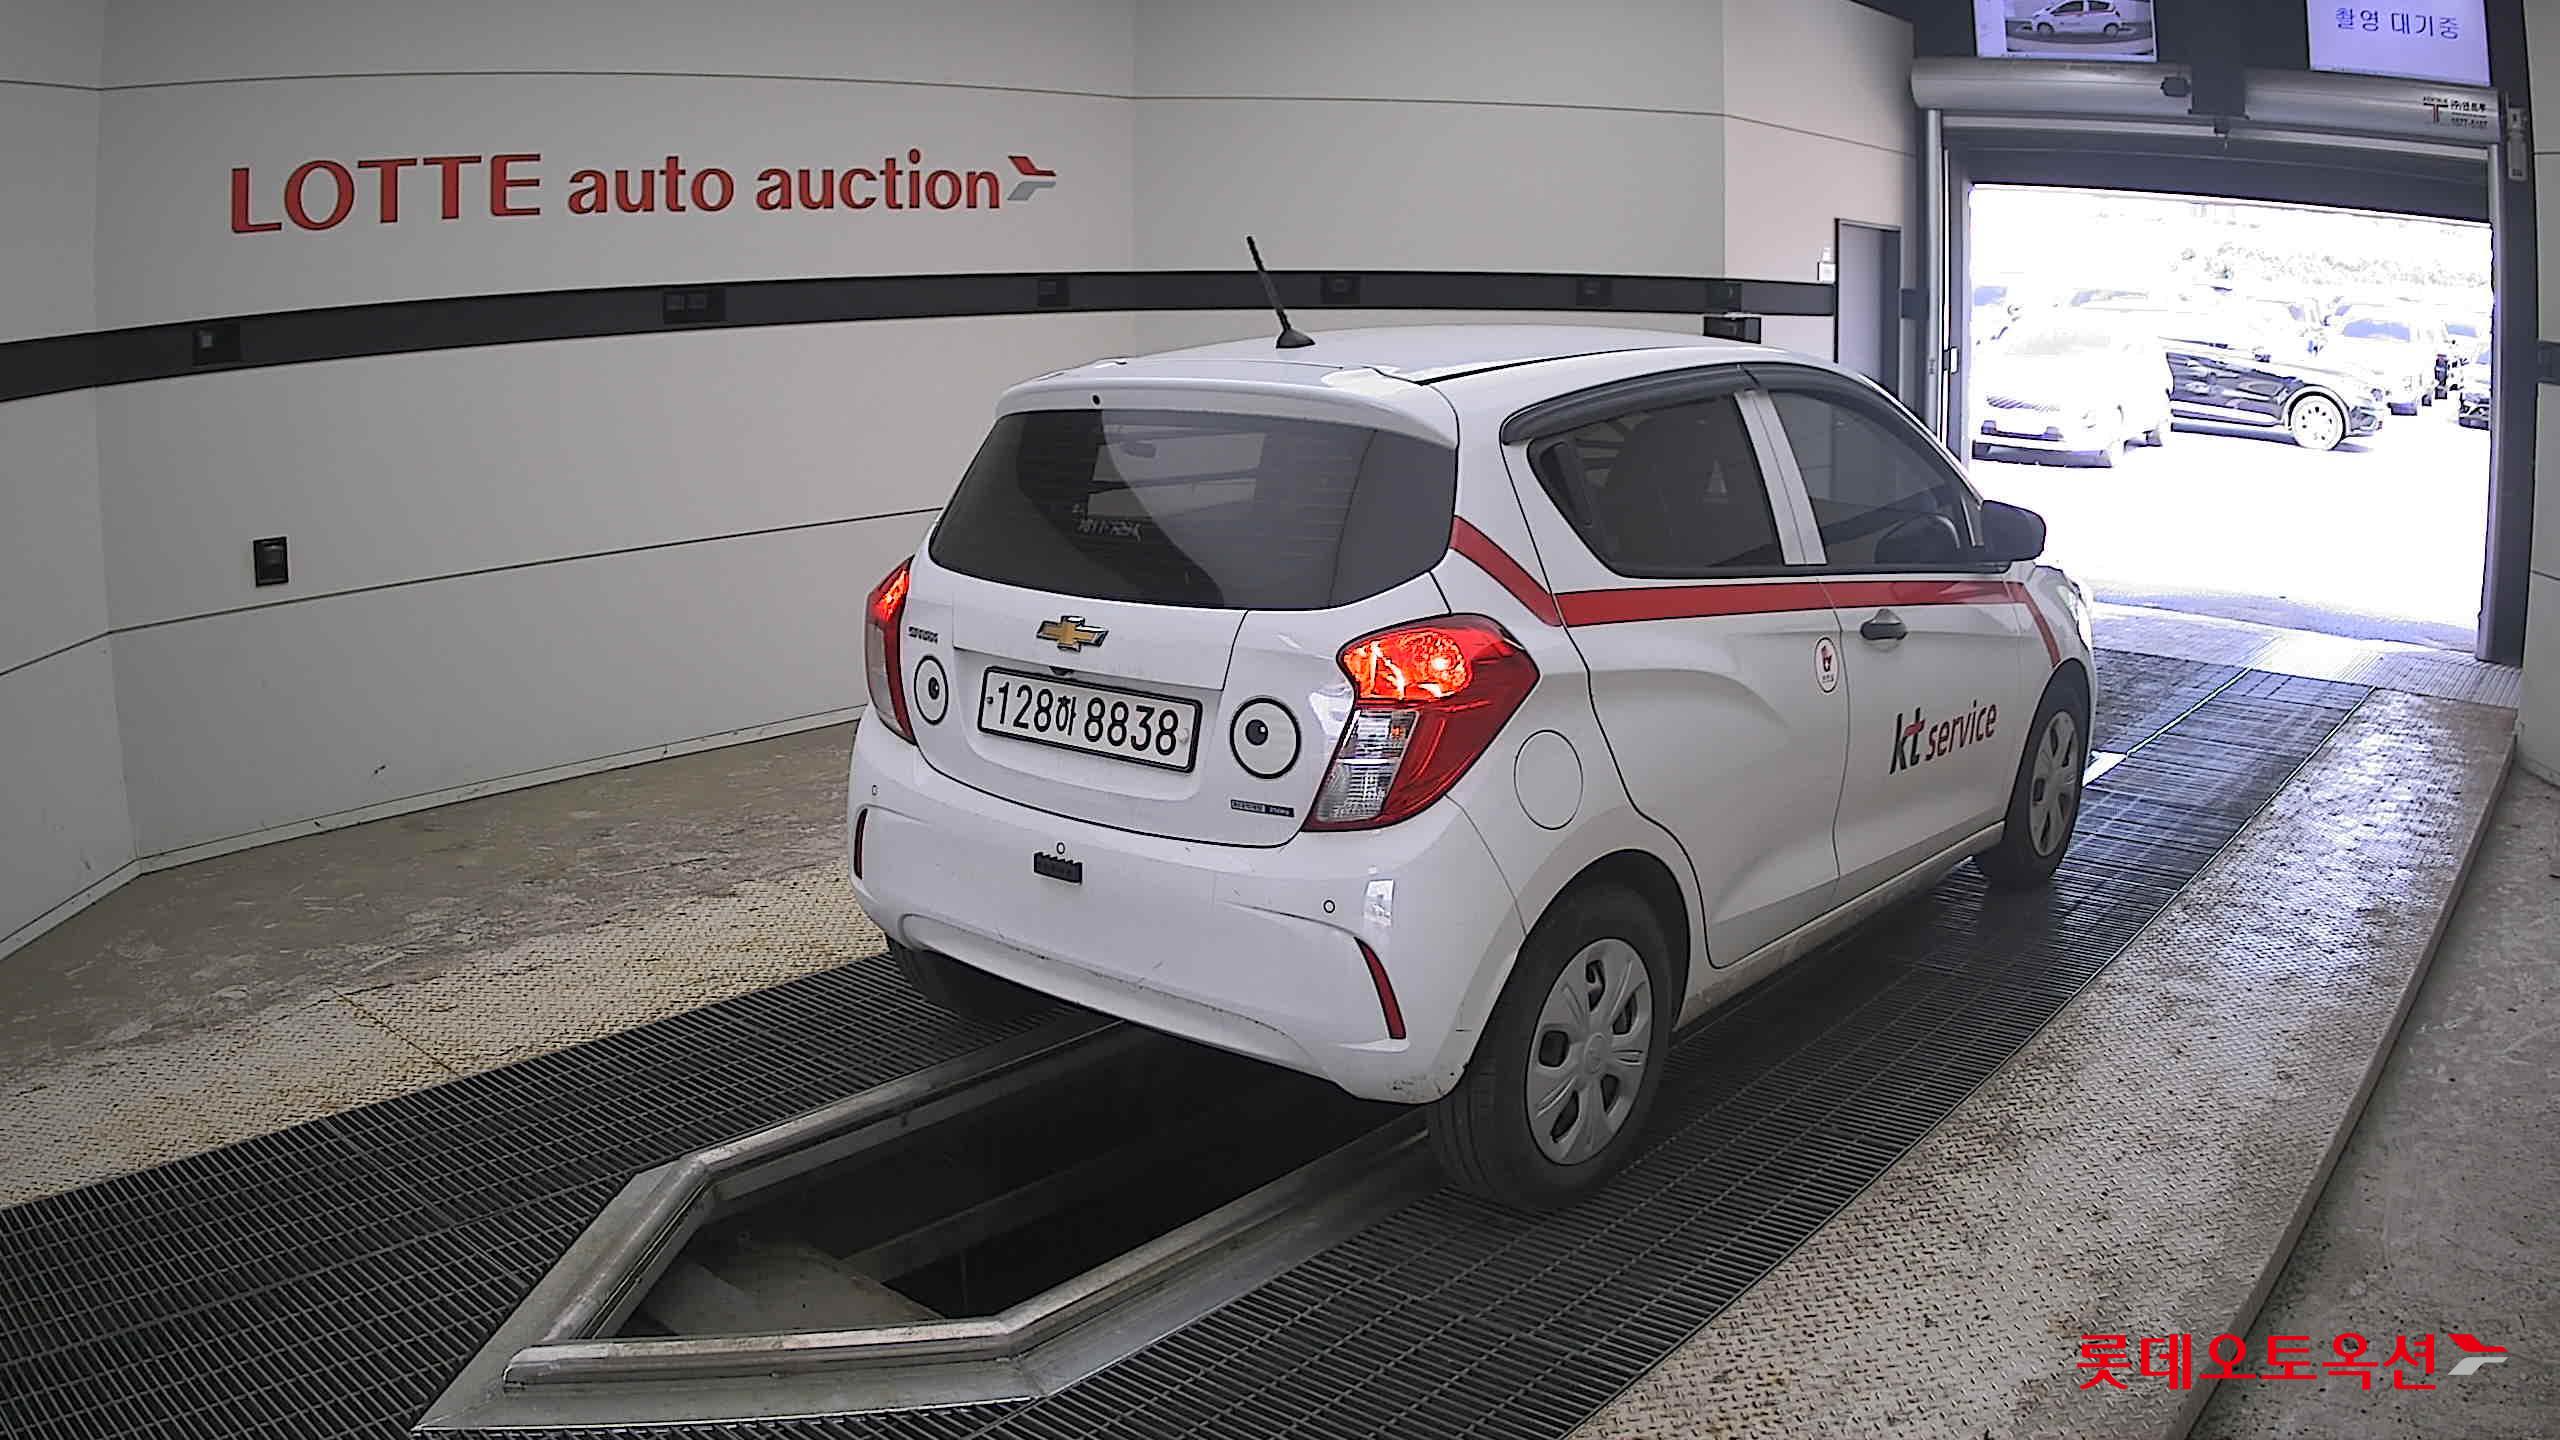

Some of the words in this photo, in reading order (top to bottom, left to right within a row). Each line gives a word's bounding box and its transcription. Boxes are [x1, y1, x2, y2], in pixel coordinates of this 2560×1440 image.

[2335, 7, 2379, 33] 촬영
[2390, 11, 2460, 40] 대기중
[230, 154, 541, 234] LOTTE
[568, 156, 737, 214] auto
[754, 149, 1003, 212] auction
[1889, 706, 1926, 775] kt
[1924, 699, 1997, 761] service
